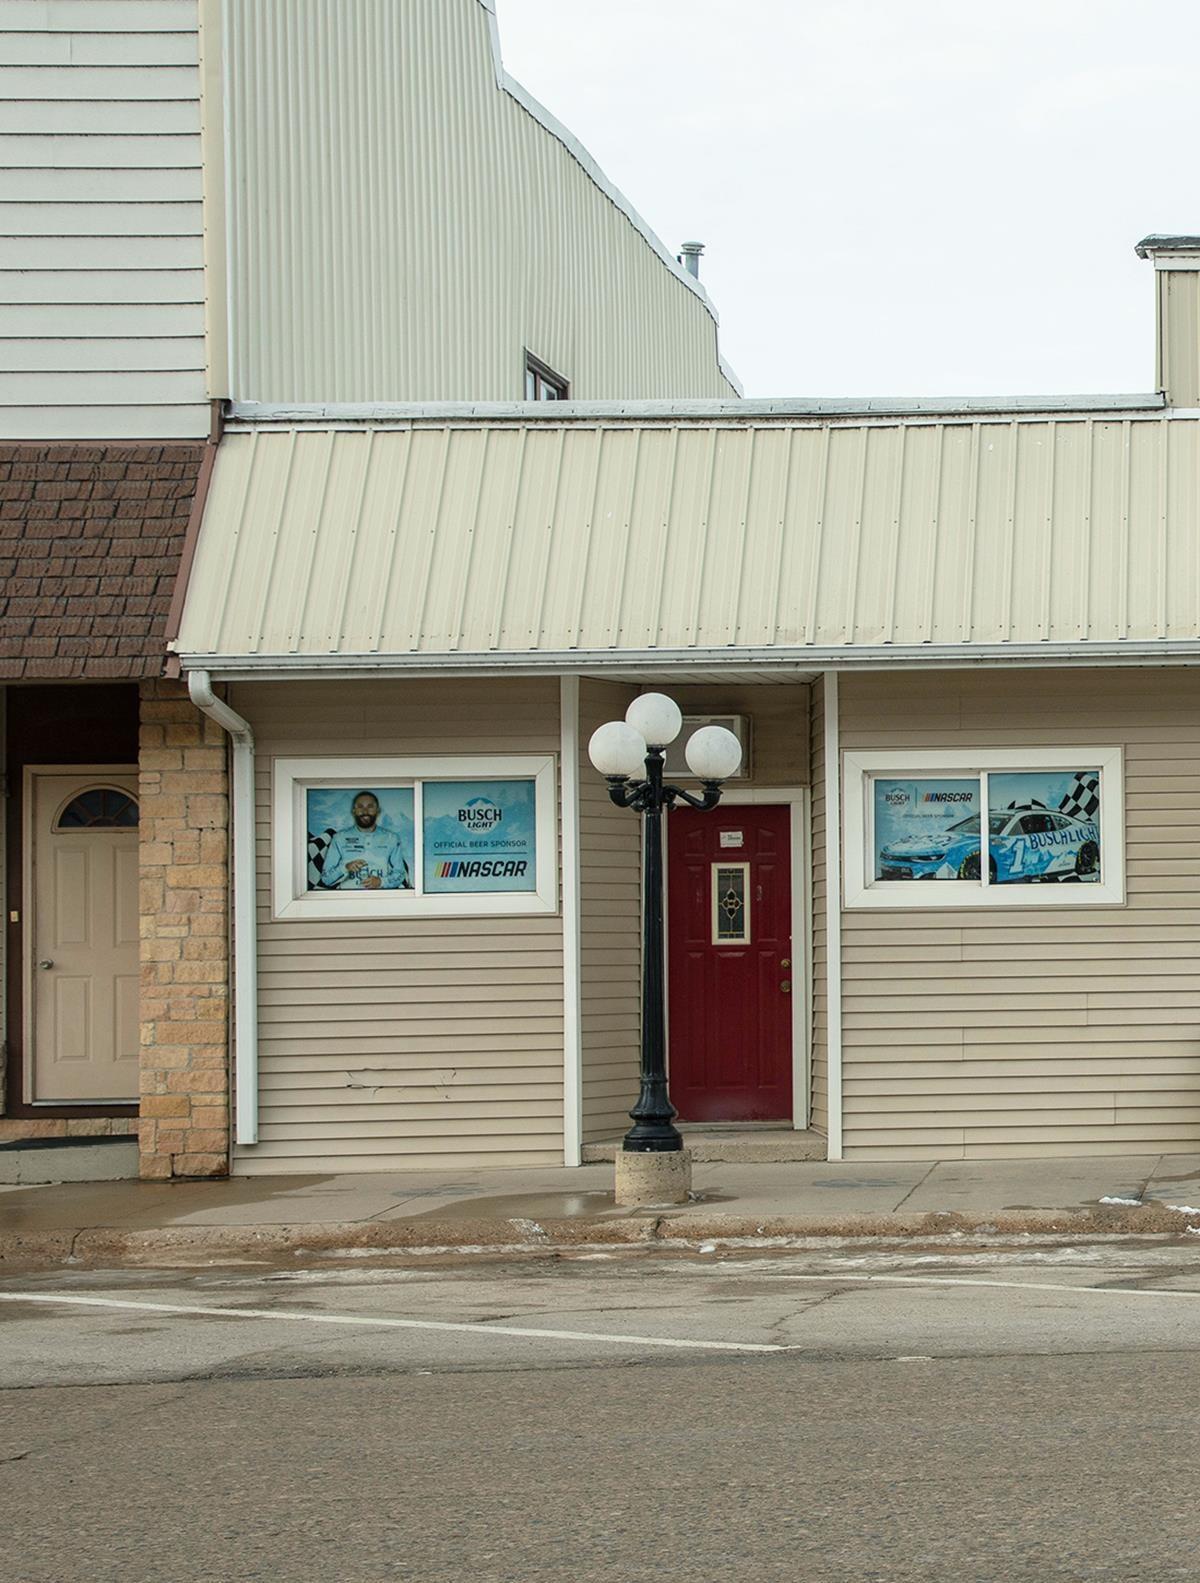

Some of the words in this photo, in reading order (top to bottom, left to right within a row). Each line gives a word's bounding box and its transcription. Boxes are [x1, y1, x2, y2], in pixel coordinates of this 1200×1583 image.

[885, 793, 910, 802] BUSCH
[934, 792, 973, 803] NASCAR
[458, 808, 502, 822] BUSCH
[467, 821, 494, 829] LIGHT
[433, 841, 467, 849] OFFICIAL
[469, 840, 489, 848] BEER
[491, 840, 527, 848] SPONSOR
[1008, 838, 1026, 875] 1
[457, 861, 528, 877] NASCAR
